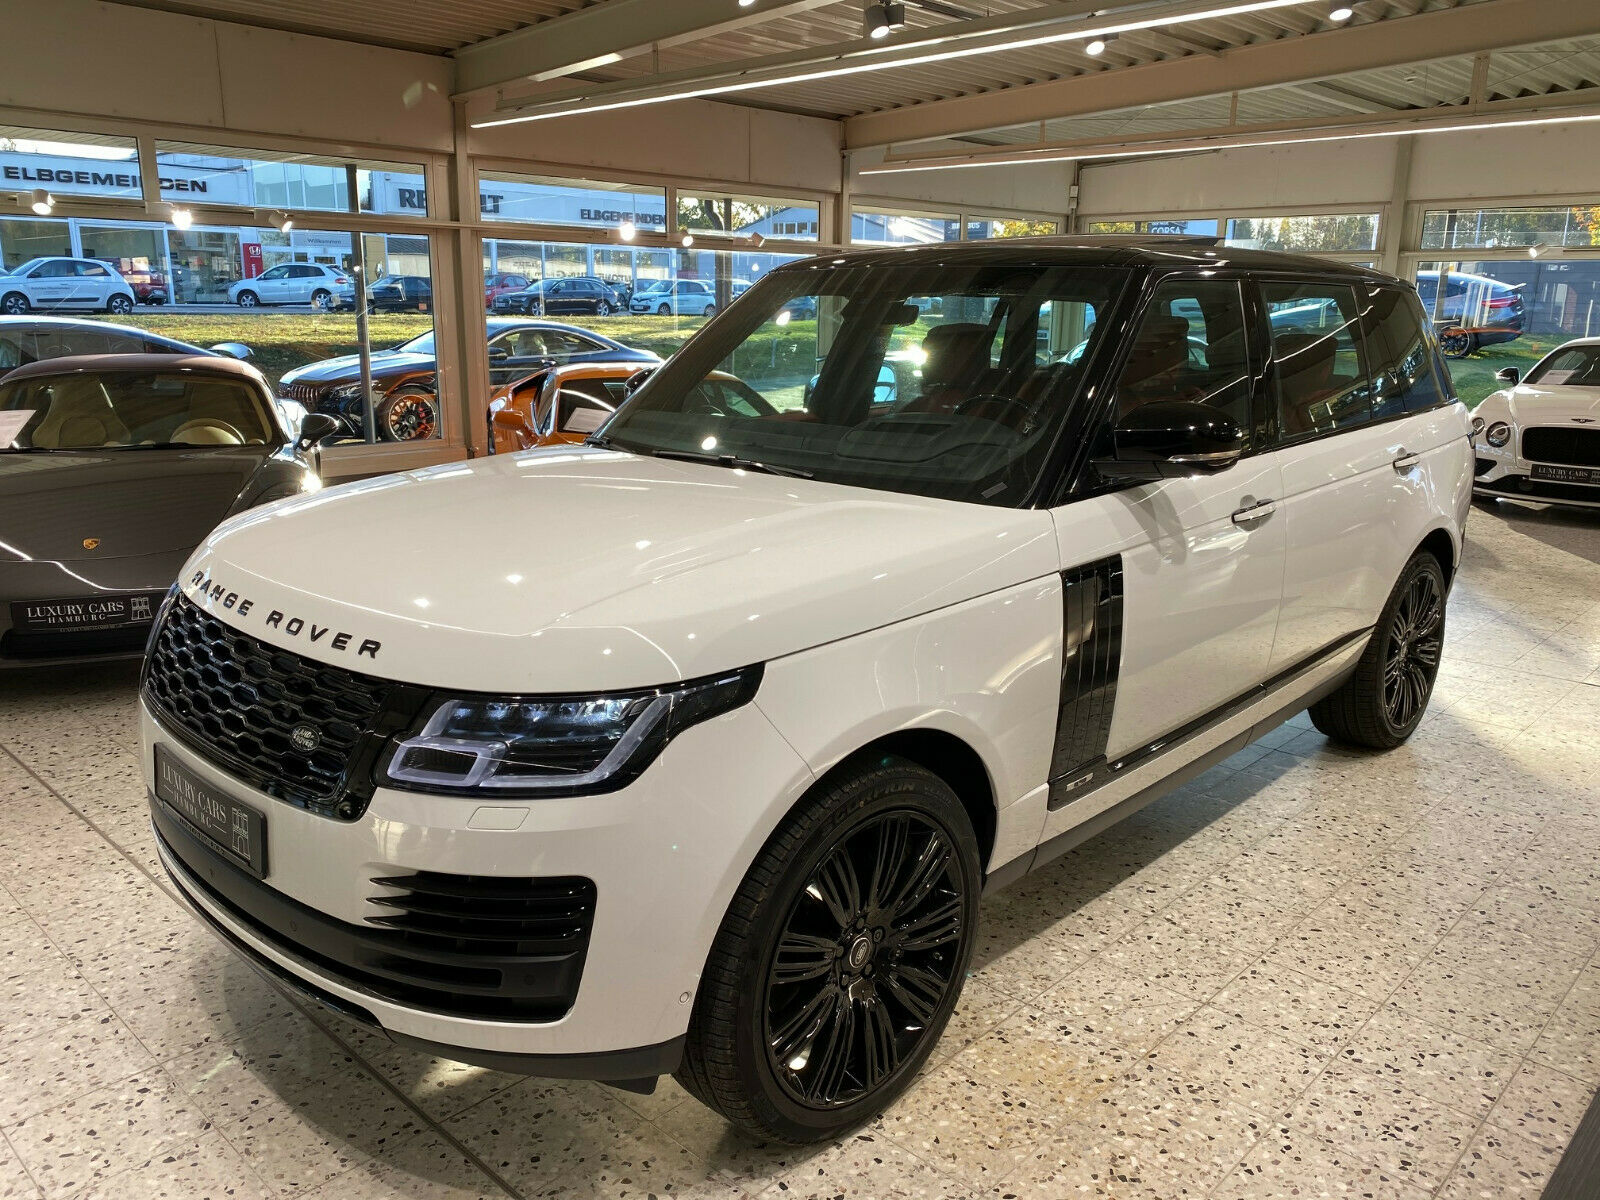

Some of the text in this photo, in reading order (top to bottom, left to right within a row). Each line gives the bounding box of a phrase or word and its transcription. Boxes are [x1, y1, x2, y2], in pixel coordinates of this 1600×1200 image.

[3, 165, 207, 193] ELBGEMEIDEN
[398, 188, 503, 214] RELT
[580, 208, 666, 225] ELBGEMENDEN
[26, 601, 125, 618] LUXURY CARS
[48, 613, 106, 624] HAMBURG
[191, 570, 382, 659] RANGE ROVER
[162, 761, 227, 824] LUXURY CARS
